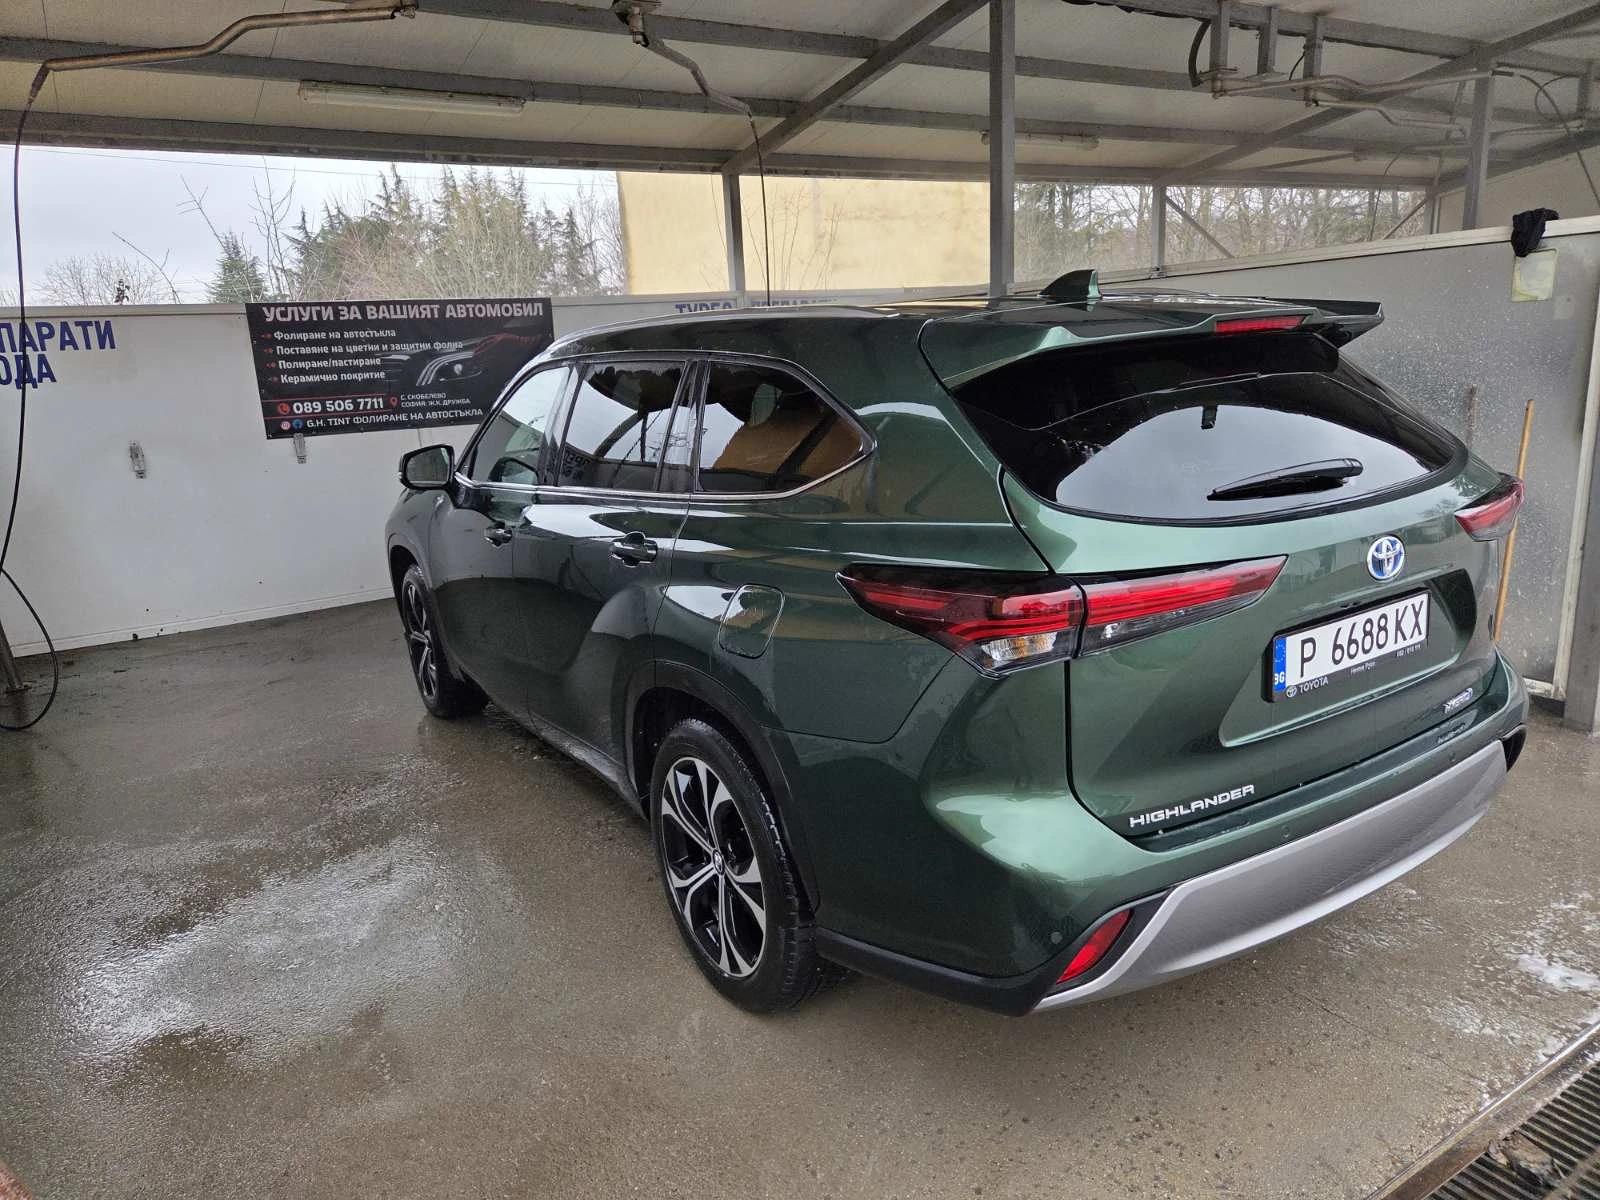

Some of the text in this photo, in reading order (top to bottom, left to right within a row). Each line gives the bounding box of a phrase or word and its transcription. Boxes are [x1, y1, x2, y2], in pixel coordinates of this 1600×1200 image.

[262, 302, 544, 322] УСЛУГИ ЗА ВАШИЯТ АВТОМОБИЛ
[273, 329, 397, 341] Фолиране на автостъкла
[276, 345, 329, 355] Поставяне
[331, 345, 344, 353] на
[346, 344, 380, 353] цветни
[382, 343, 389, 351] и
[390, 341, 432, 352] защитни
[278, 357, 381, 370] Полиране/пастиране
[280, 371, 386, 384] Керамично покритие
[293, 397, 384, 414] 089 506 7711
[327, 416, 351, 426] TINT
[353, 413, 409, 424] ФОЛИРАНЕ
[410, 412, 425, 421] НА
[425, 408, 484, 420] АВТОСТЪКЛА
[1300, 600, 1424, 678] P 6688 KX
[1299, 676, 1329, 694] TOYOTA
[1129, 784, 1255, 828] HIGHLANDER
